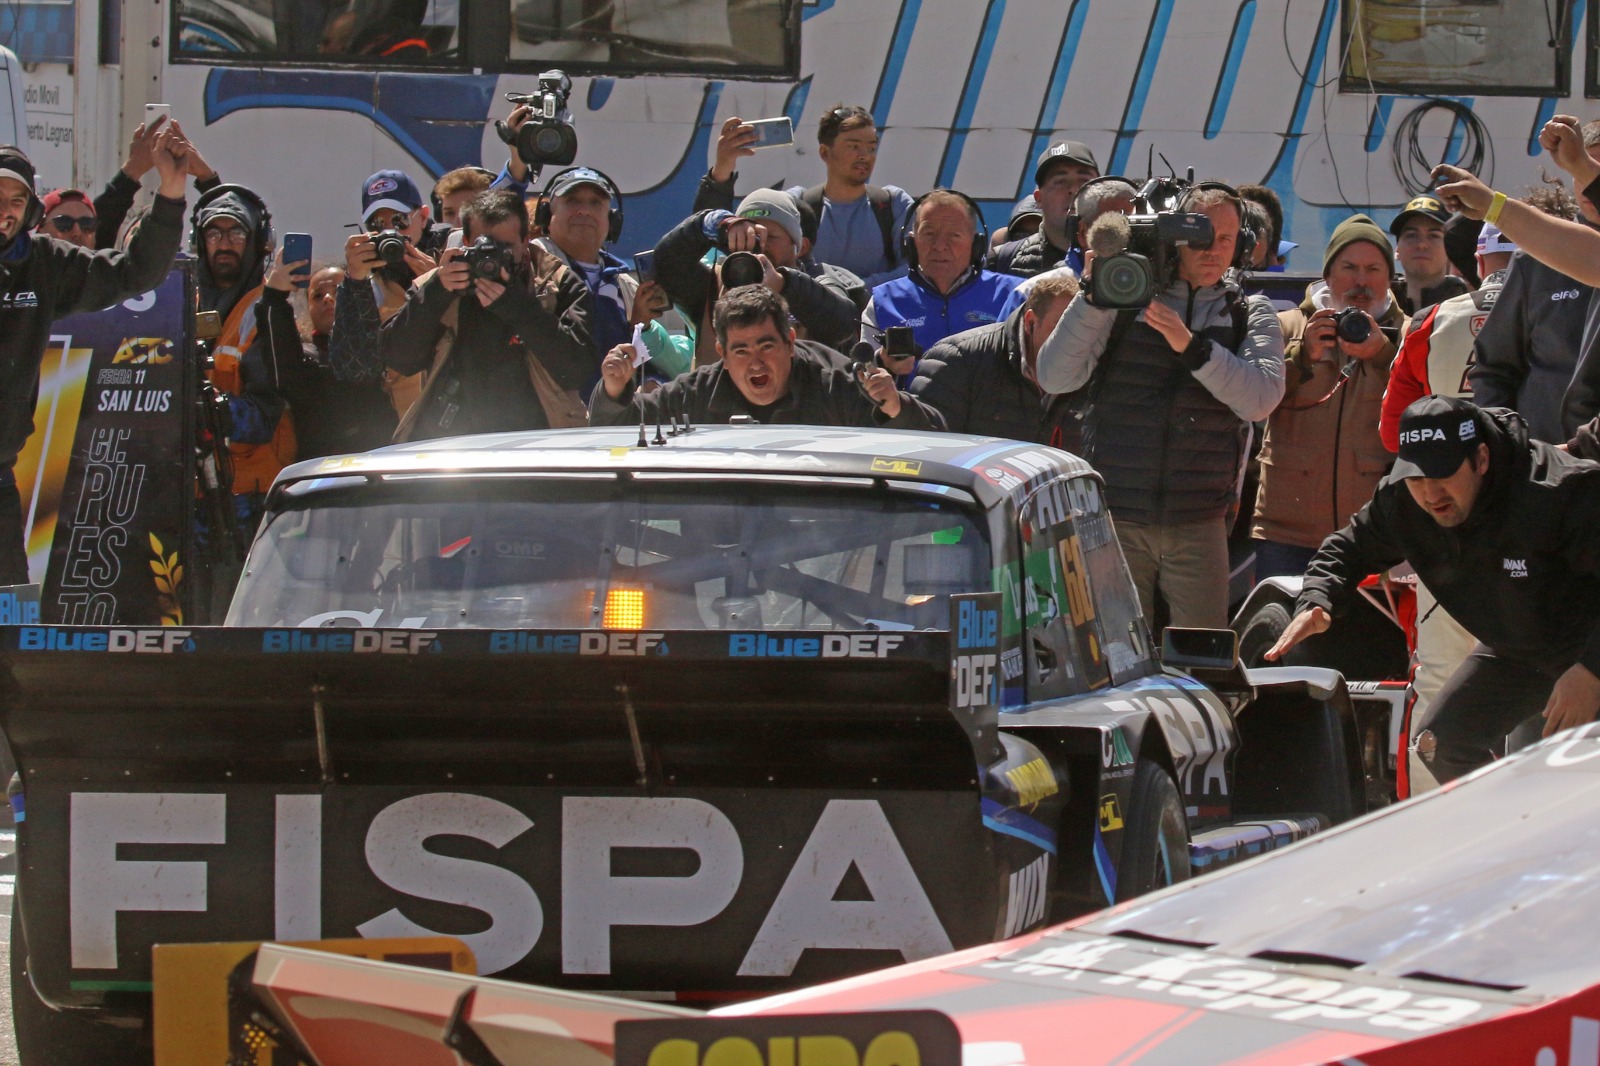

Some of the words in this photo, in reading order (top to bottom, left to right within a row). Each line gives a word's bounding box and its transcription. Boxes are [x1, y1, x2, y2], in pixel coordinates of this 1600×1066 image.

[28, 122, 43, 140] erto
[112, 337, 174, 364] ACTC
[97, 368, 132, 385] FECHA
[135, 369, 146, 384] 11
[98, 389, 132, 412] SAN
[134, 390, 172, 412] LUIS
[1400, 428, 1447, 446] FISPA
[75, 464, 145, 525] PU
[61, 526, 127, 588] ES
[0, 592, 39, 625] Blue
[958, 600, 997, 648] Blue
[19, 628, 191, 653] BlueDEF
[262, 630, 438, 655] BlueDEF
[490, 631, 665, 656] BlueDEF
[728, 633, 905, 658] BlueDEF
[957, 654, 996, 707] DEF
[70, 792, 955, 976] FISPA
[1100, 953, 1482, 1031] Kappa
